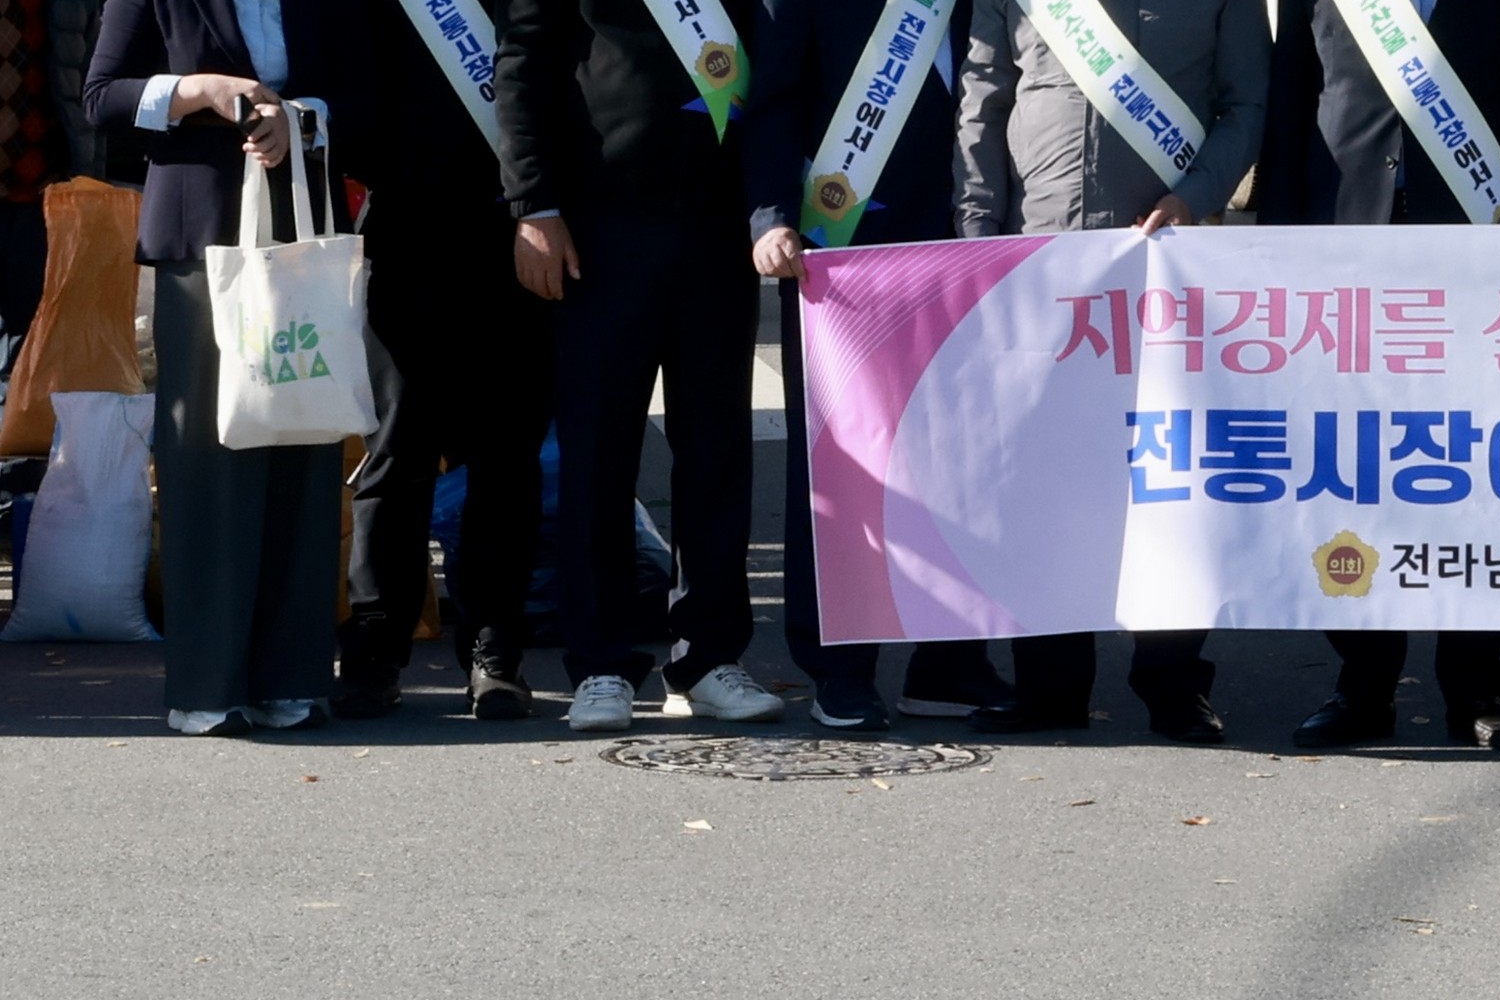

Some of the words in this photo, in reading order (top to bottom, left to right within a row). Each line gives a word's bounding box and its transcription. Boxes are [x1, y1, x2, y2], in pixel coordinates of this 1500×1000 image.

[841, 10, 926, 171] 전통시장에서!
[1398, 55, 1498, 205] 전통시장에서!
[1055, 286, 1455, 376] 지역경제를
[1329, 557, 1362, 576] 의회
